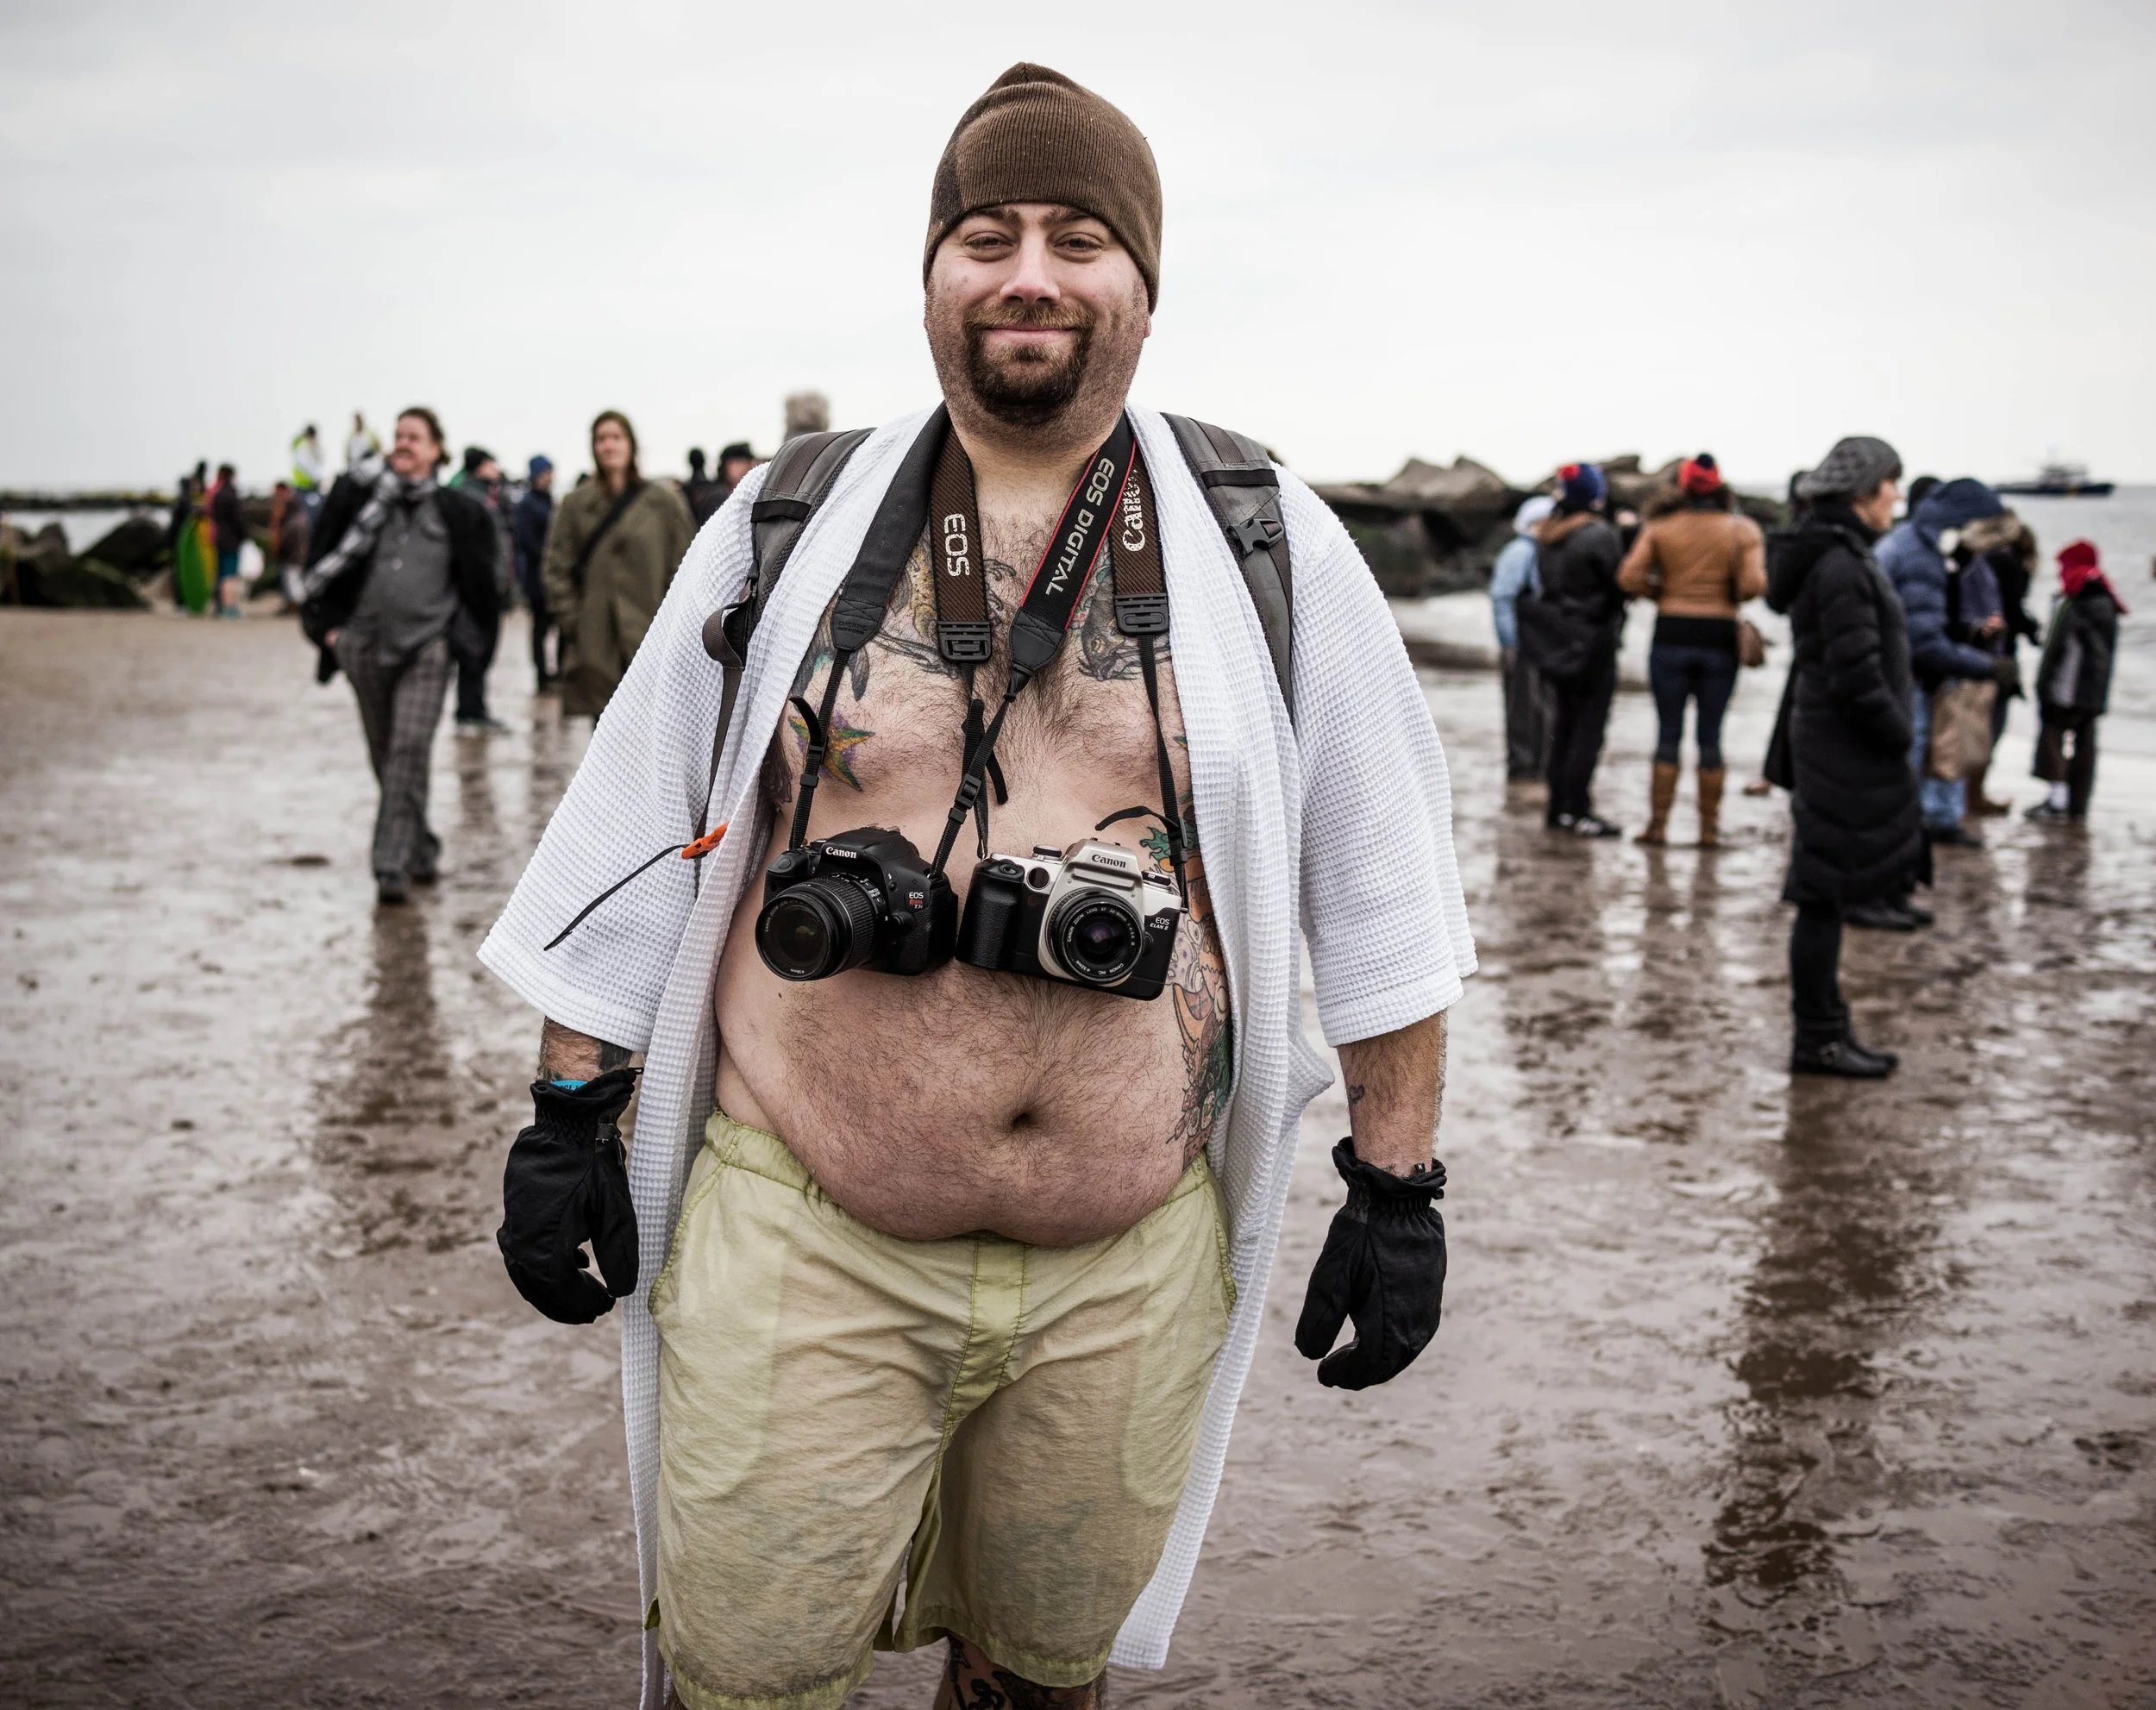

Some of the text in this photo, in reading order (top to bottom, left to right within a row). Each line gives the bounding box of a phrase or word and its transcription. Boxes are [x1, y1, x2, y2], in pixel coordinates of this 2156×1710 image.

[1122, 469, 1146, 552] Can
[1045, 457, 1115, 596] EOS DIGITAL
[943, 513, 970, 577] EOS
[825, 846, 857, 859] Canon
[1091, 854, 1126, 868] Canon
[1073, 913, 1084, 924] ZOOM
[1155, 917, 1169, 925] EOS
[1109, 962, 1124, 974] CANON
